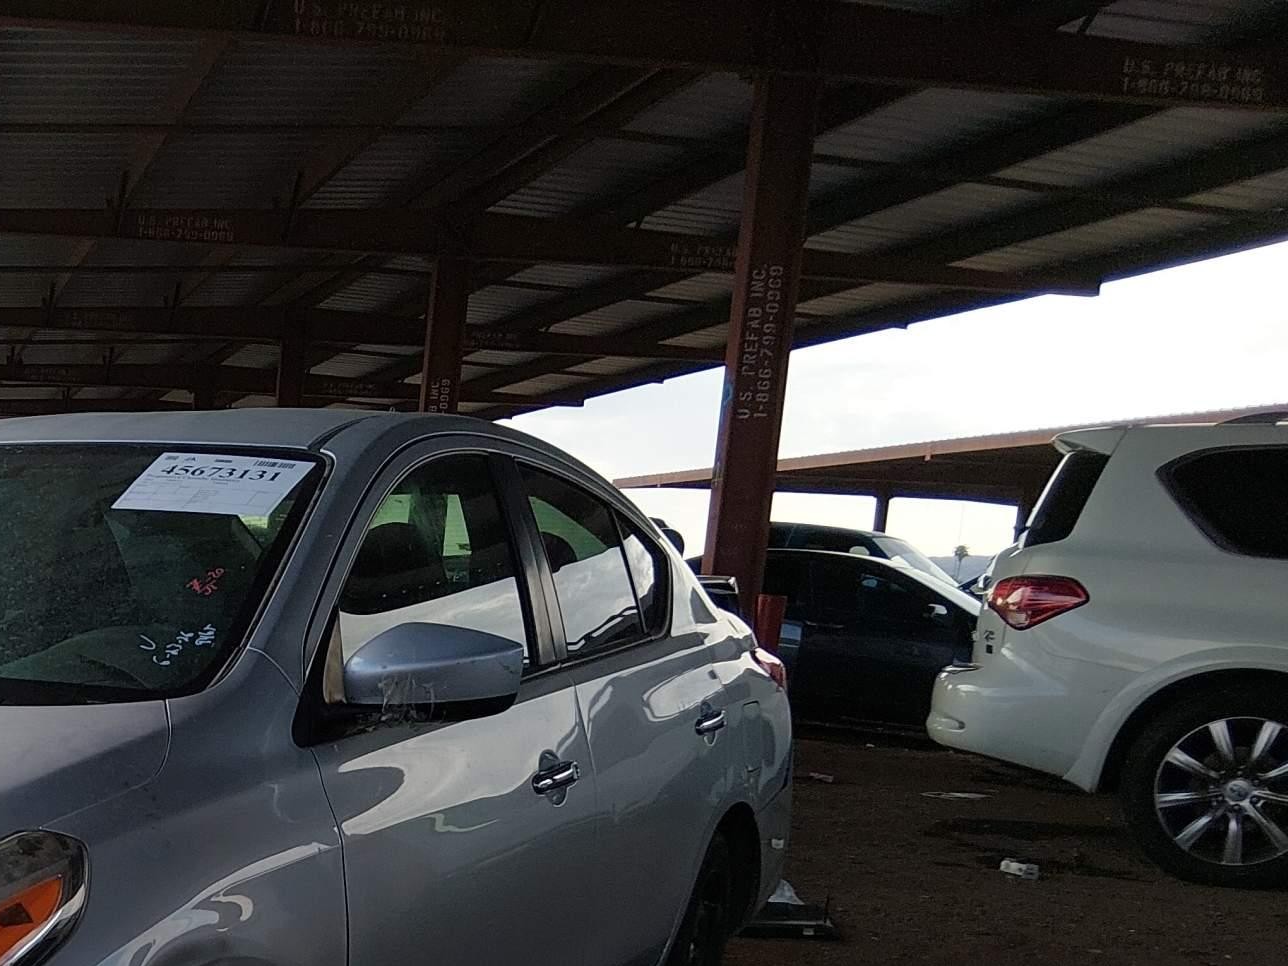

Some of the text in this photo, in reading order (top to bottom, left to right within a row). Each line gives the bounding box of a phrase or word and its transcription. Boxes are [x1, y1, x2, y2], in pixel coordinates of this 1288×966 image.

[736, 263, 768, 420] U.S. PREFAB INC.
[753, 264, 784, 419] 1-866-799-0969
[160, 463, 283, 483] 45673131
